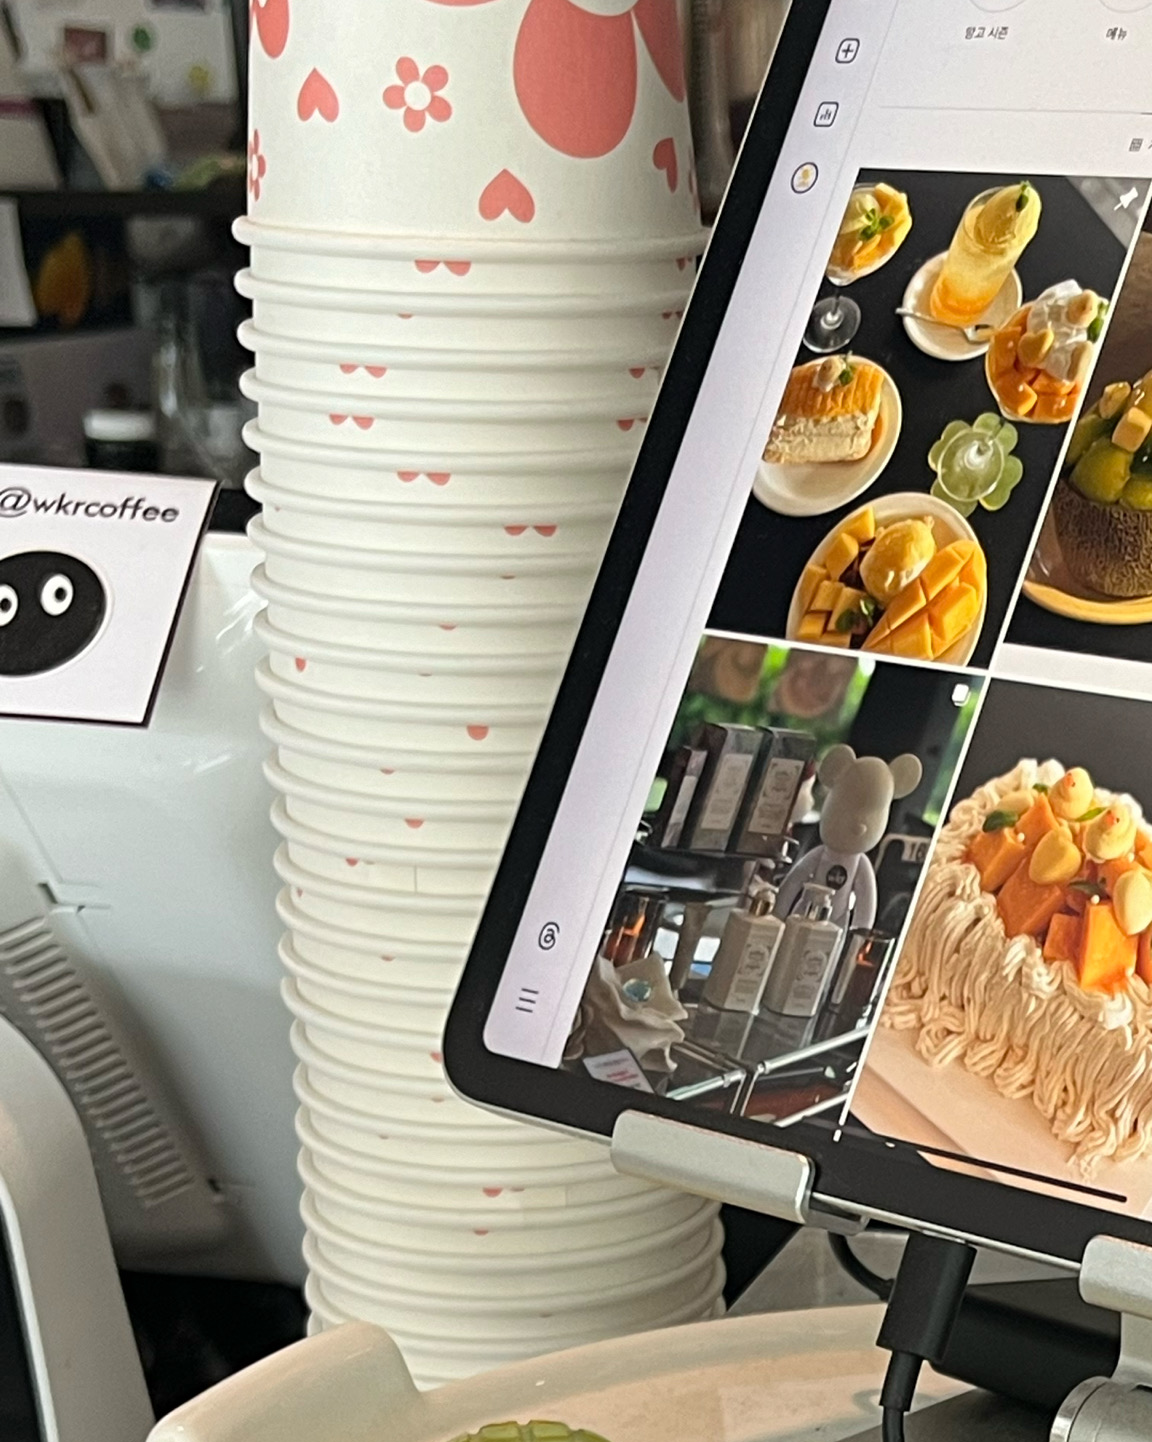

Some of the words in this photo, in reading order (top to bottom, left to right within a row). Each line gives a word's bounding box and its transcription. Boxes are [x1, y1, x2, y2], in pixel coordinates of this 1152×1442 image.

[988, 26, 1009, 40] 시즌
[1105, 27, 1128, 41] 메뉴
[0, 486, 180, 523] @wkrcoffee
